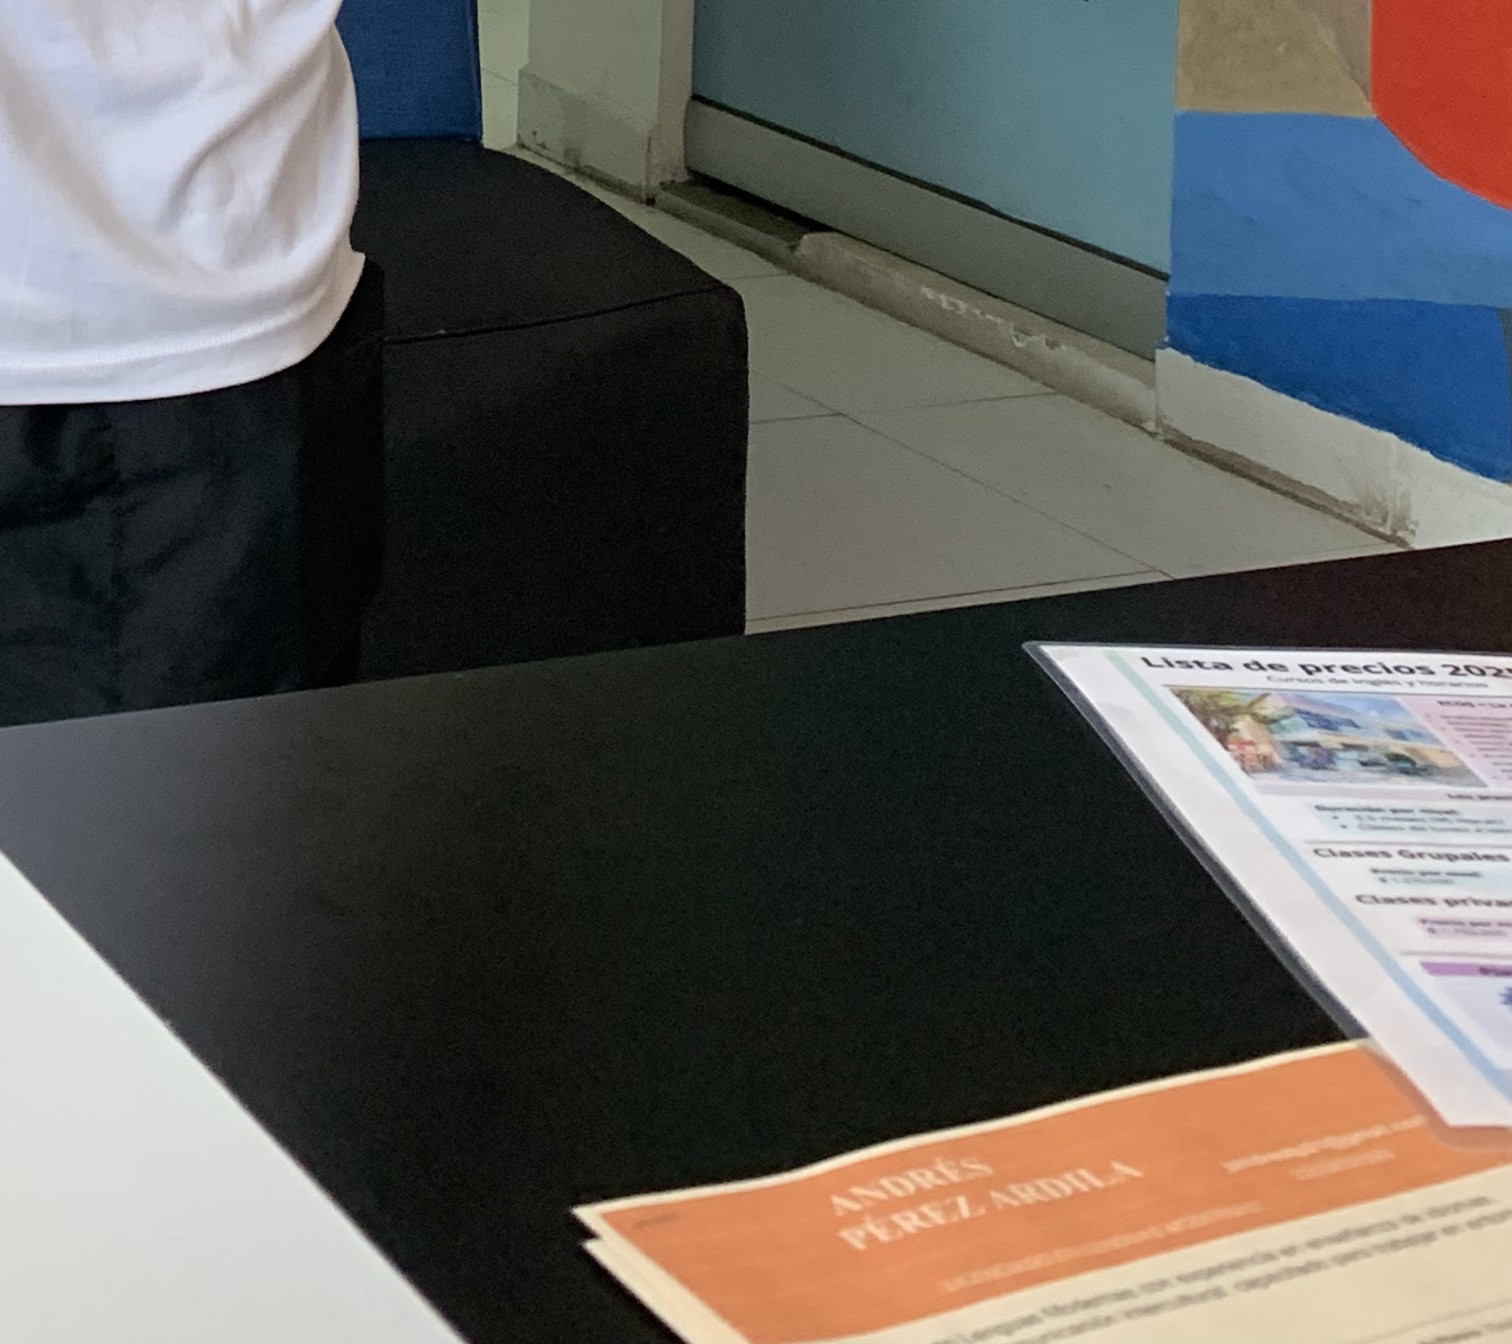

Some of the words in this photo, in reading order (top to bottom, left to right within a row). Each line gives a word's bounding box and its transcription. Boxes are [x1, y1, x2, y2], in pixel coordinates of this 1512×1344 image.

[1140, 656, 1233, 672] Lista
[1243, 659, 1288, 673] de
[1299, 660, 1436, 678] precios
[1312, 847, 1393, 860] Clases
[1397, 848, 1511, 863] Grupales
[1354, 893, 1438, 906] Clases
[830, 1155, 994, 1217] ANDRÉS
[836, 1194, 987, 1252] PÉREZ
[989, 1160, 1145, 1210] ARDILA
